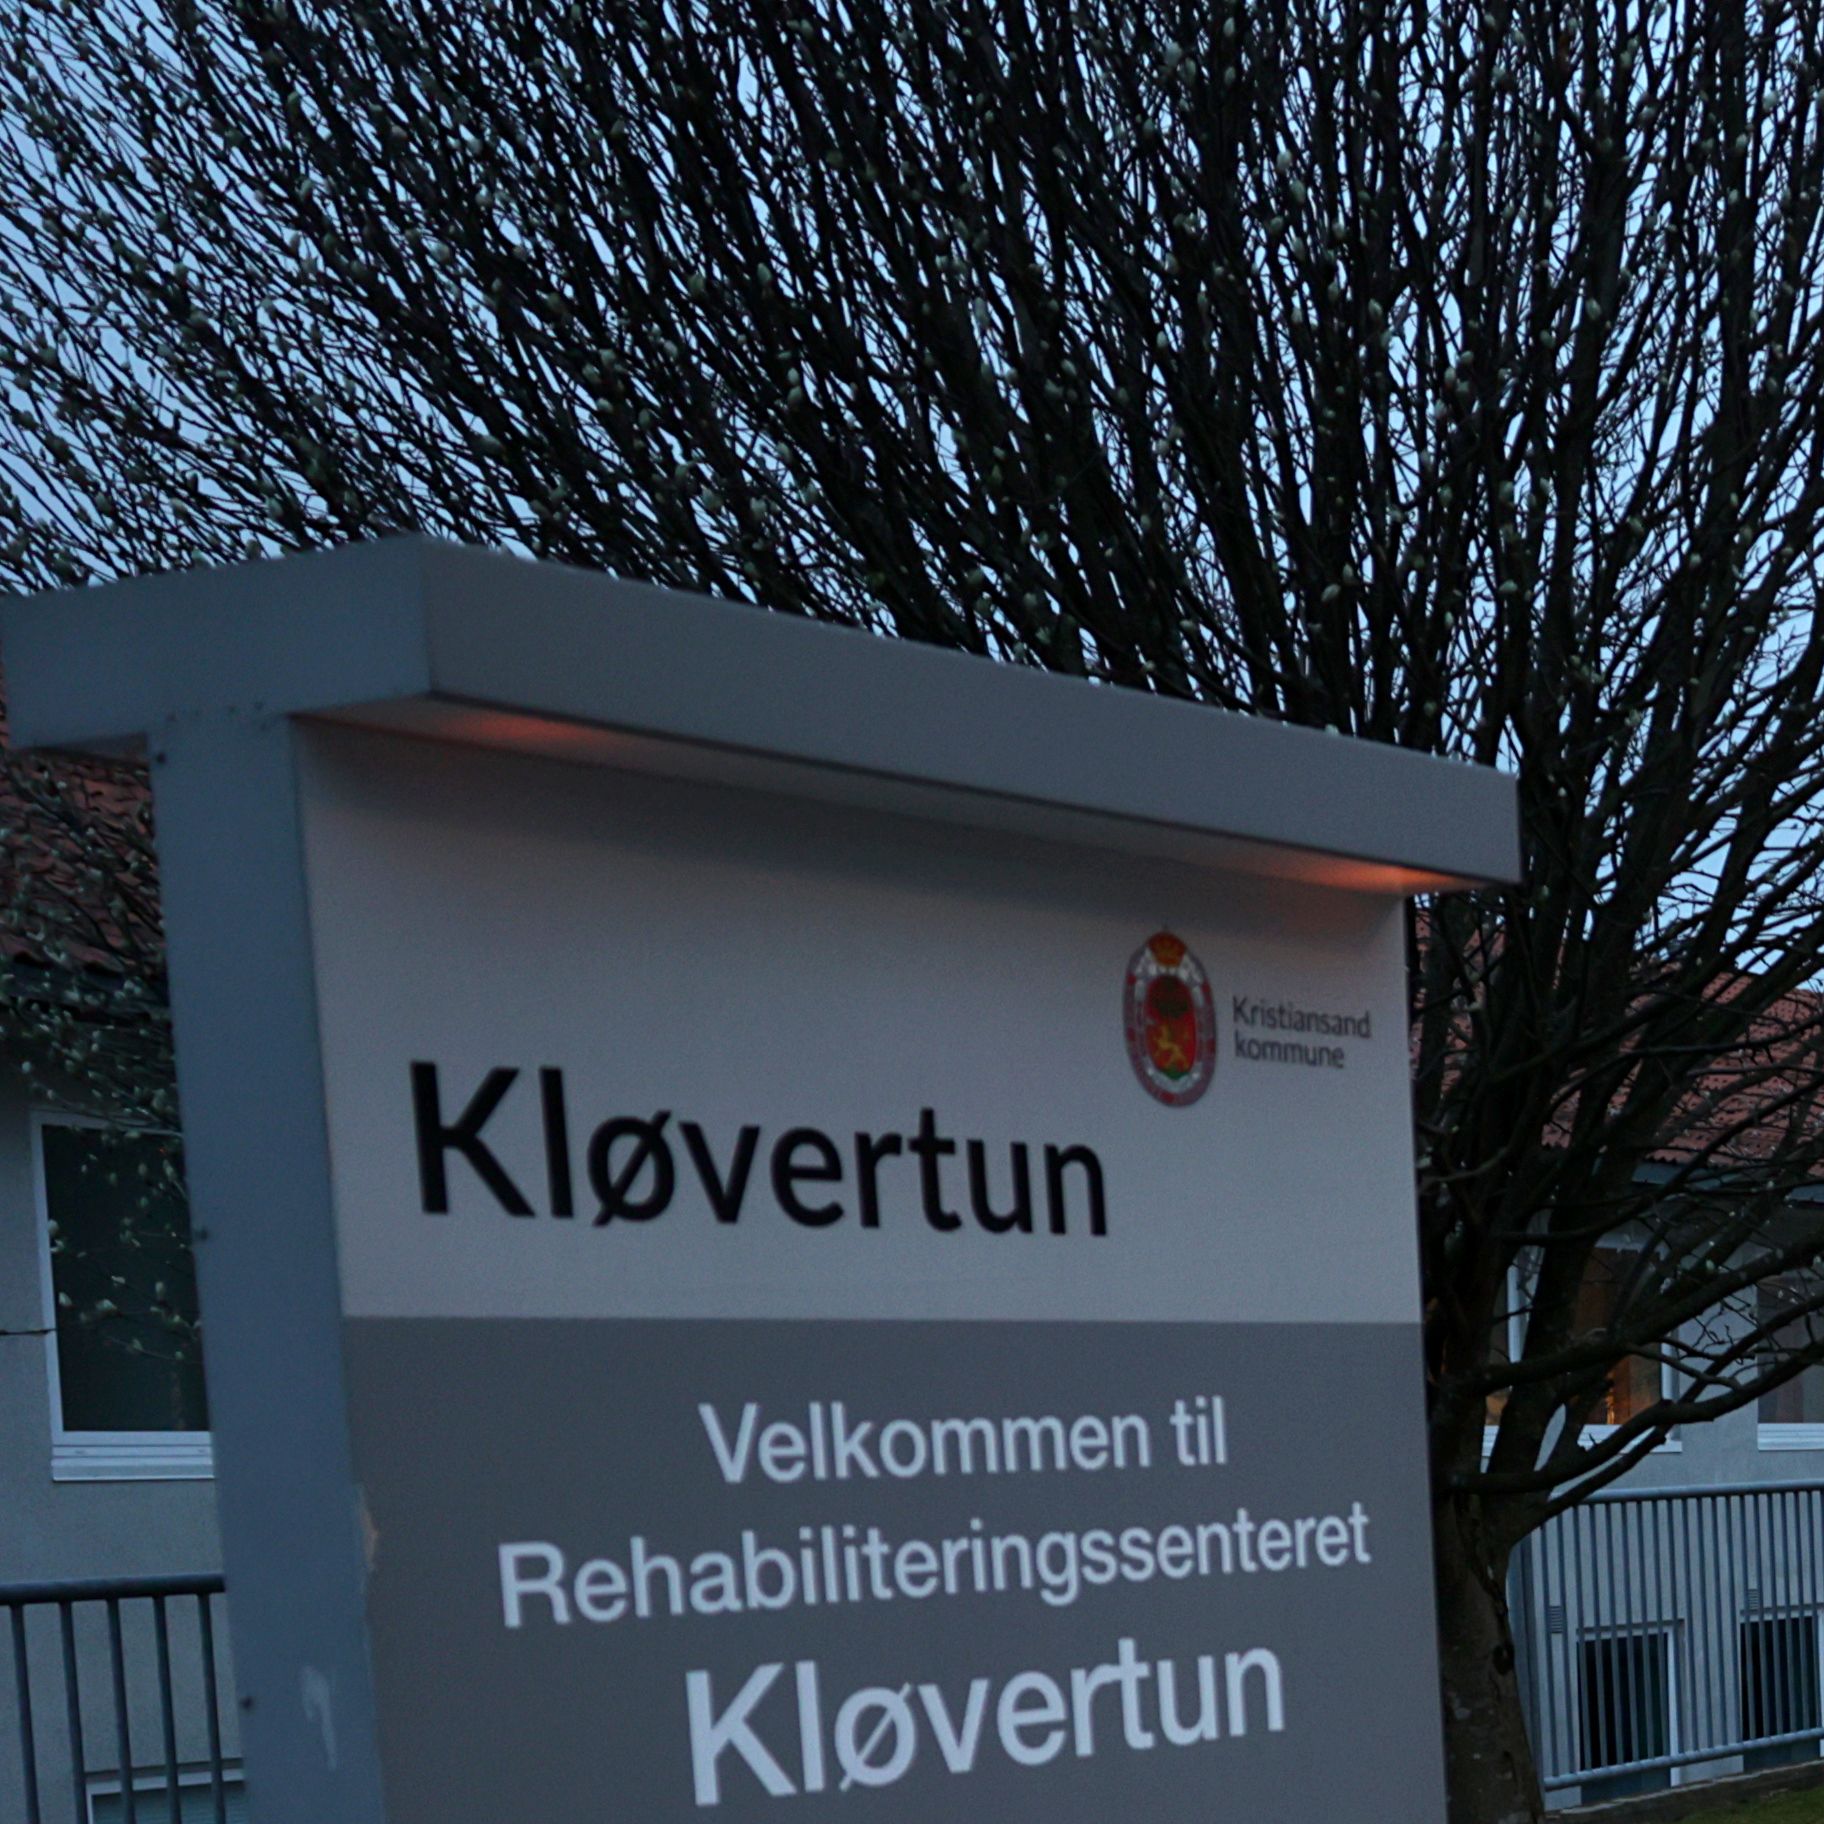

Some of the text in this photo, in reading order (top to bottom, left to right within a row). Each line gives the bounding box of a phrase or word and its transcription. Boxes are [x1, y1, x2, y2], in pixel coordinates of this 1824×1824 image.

[1232, 996, 1371, 1038] Kristiansand
[1234, 1030, 1345, 1068] kommune
[410, 1061, 1109, 1237] Kløvertun
[699, 1396, 1229, 1484] Velkommen til
[497, 1503, 1372, 1629] Rehabiliteringssenteret
[685, 1637, 1286, 1807] Kløvertun
